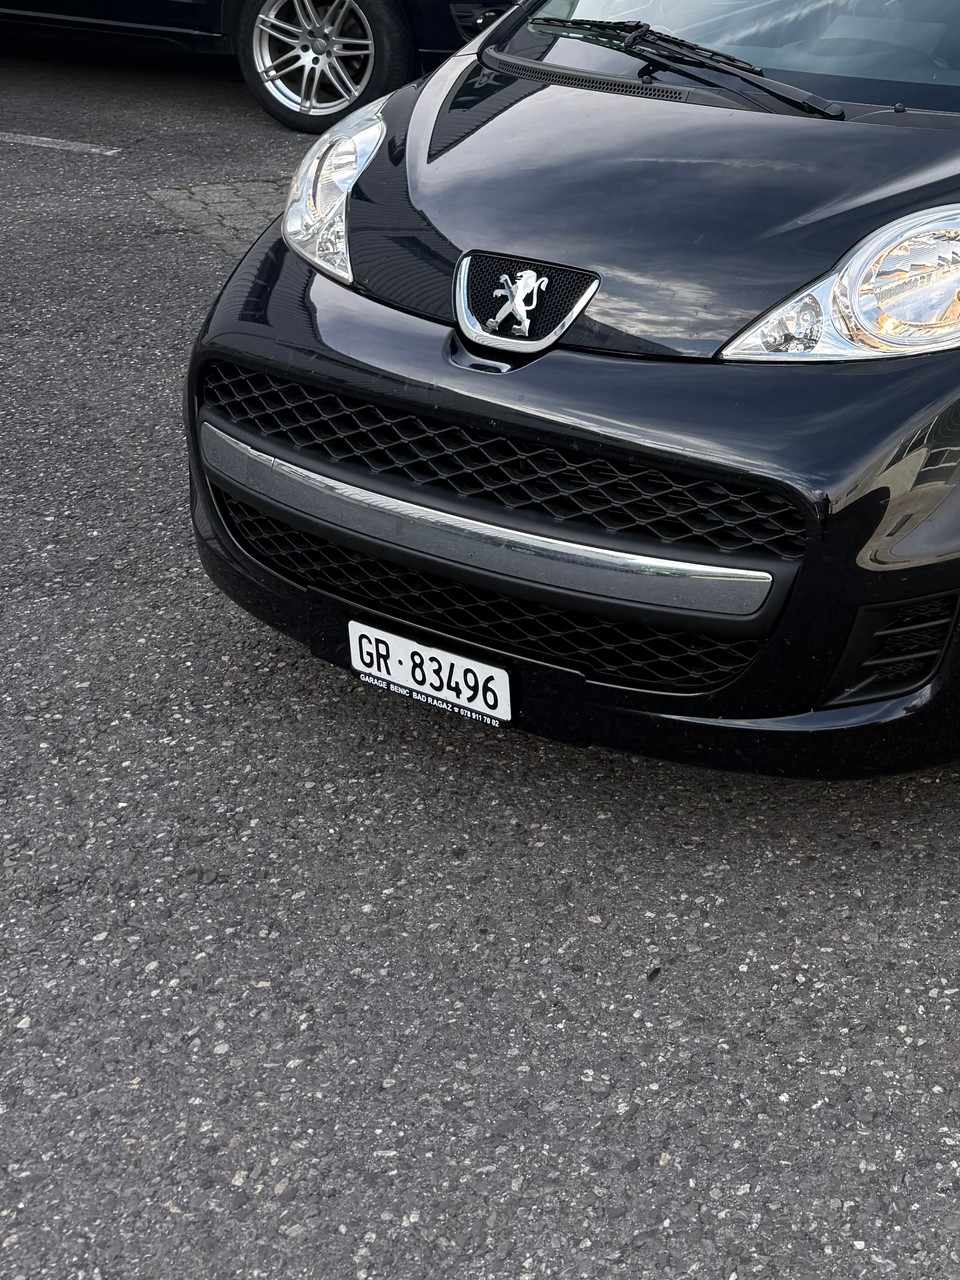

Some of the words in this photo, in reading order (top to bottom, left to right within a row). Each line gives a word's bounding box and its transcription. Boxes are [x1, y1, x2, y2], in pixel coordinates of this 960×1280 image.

[358, 633, 391, 676] GR
[410, 650, 499, 711] 83496
[360, 674, 387, 688] GARAGE
[390, 684, 409, 696] BENIC
[412, 692, 426, 703] BAD
[428, 698, 453, 711] RAGAZ
[472, 712, 482, 721] 911
